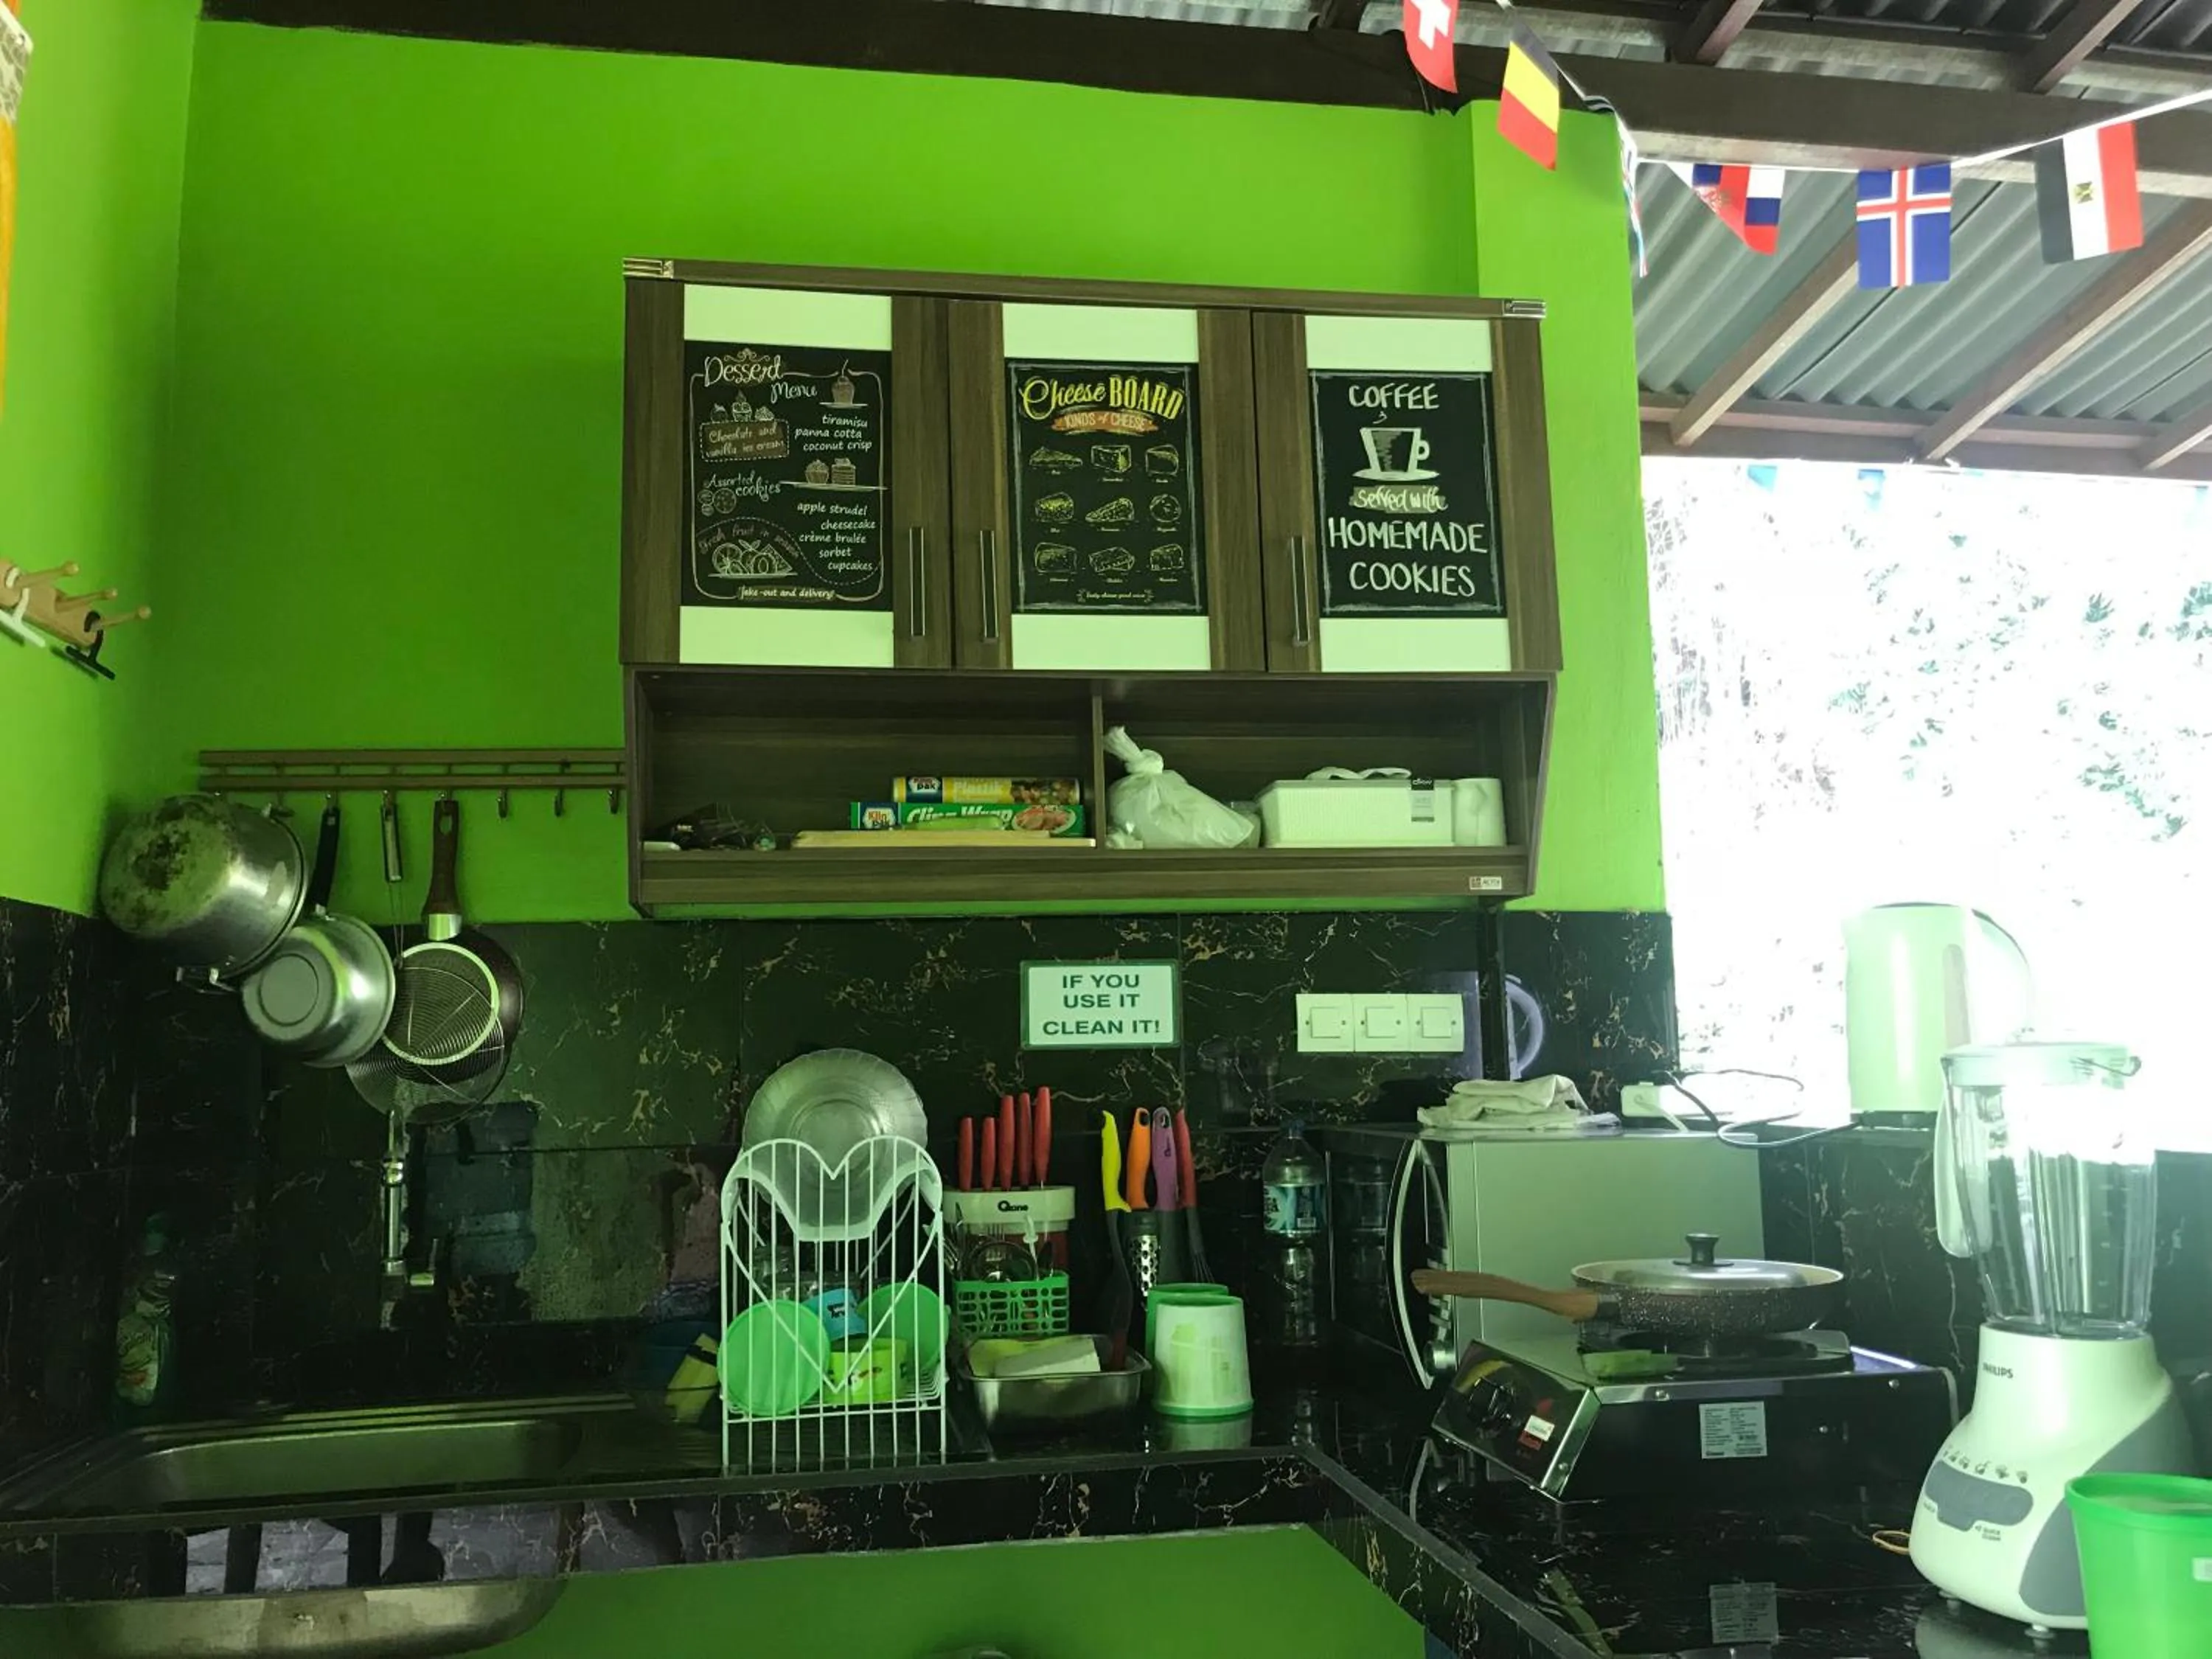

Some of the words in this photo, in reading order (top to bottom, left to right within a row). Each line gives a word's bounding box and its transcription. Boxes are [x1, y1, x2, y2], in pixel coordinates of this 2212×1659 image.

[704, 355, 784, 387] Dessert
[771, 381, 818, 404] Menu
[1019, 377, 1107, 420] Cheese
[1108, 375, 1186, 420] BOARD
[1349, 383, 1440, 410] COFFEE
[822, 414, 868, 428] tiramisu
[1065, 411, 1096, 429] KINDS
[1110, 411, 1147, 432] CHEESE
[794, 428, 830, 440] panna
[833, 428, 862, 439] cotta
[803, 440, 844, 452] coconut
[846, 439, 873, 453] crisp
[735, 476, 782, 502] cookies
[1409, 485, 1450, 513] with
[797, 501, 827, 515] apple
[829, 504, 868, 516] strudel
[820, 518, 876, 530] cheesecake
[1328, 516, 1488, 554] HOMEMADE
[819, 546, 852, 559] sorbet
[827, 560, 873, 574] cupcakes
[1349, 560, 1475, 597] COOKIES
[1062, 975, 1083, 989] IF
[1091, 973, 1140, 988] YOU
[1063, 994, 1111, 1009] USE
[1119, 993, 1141, 1008] IT
[1042, 1020, 1123, 1035] CLEAN
[1132, 1019, 1161, 1034] IT!
[1982, 1361, 2014, 1379] PHILIPS
